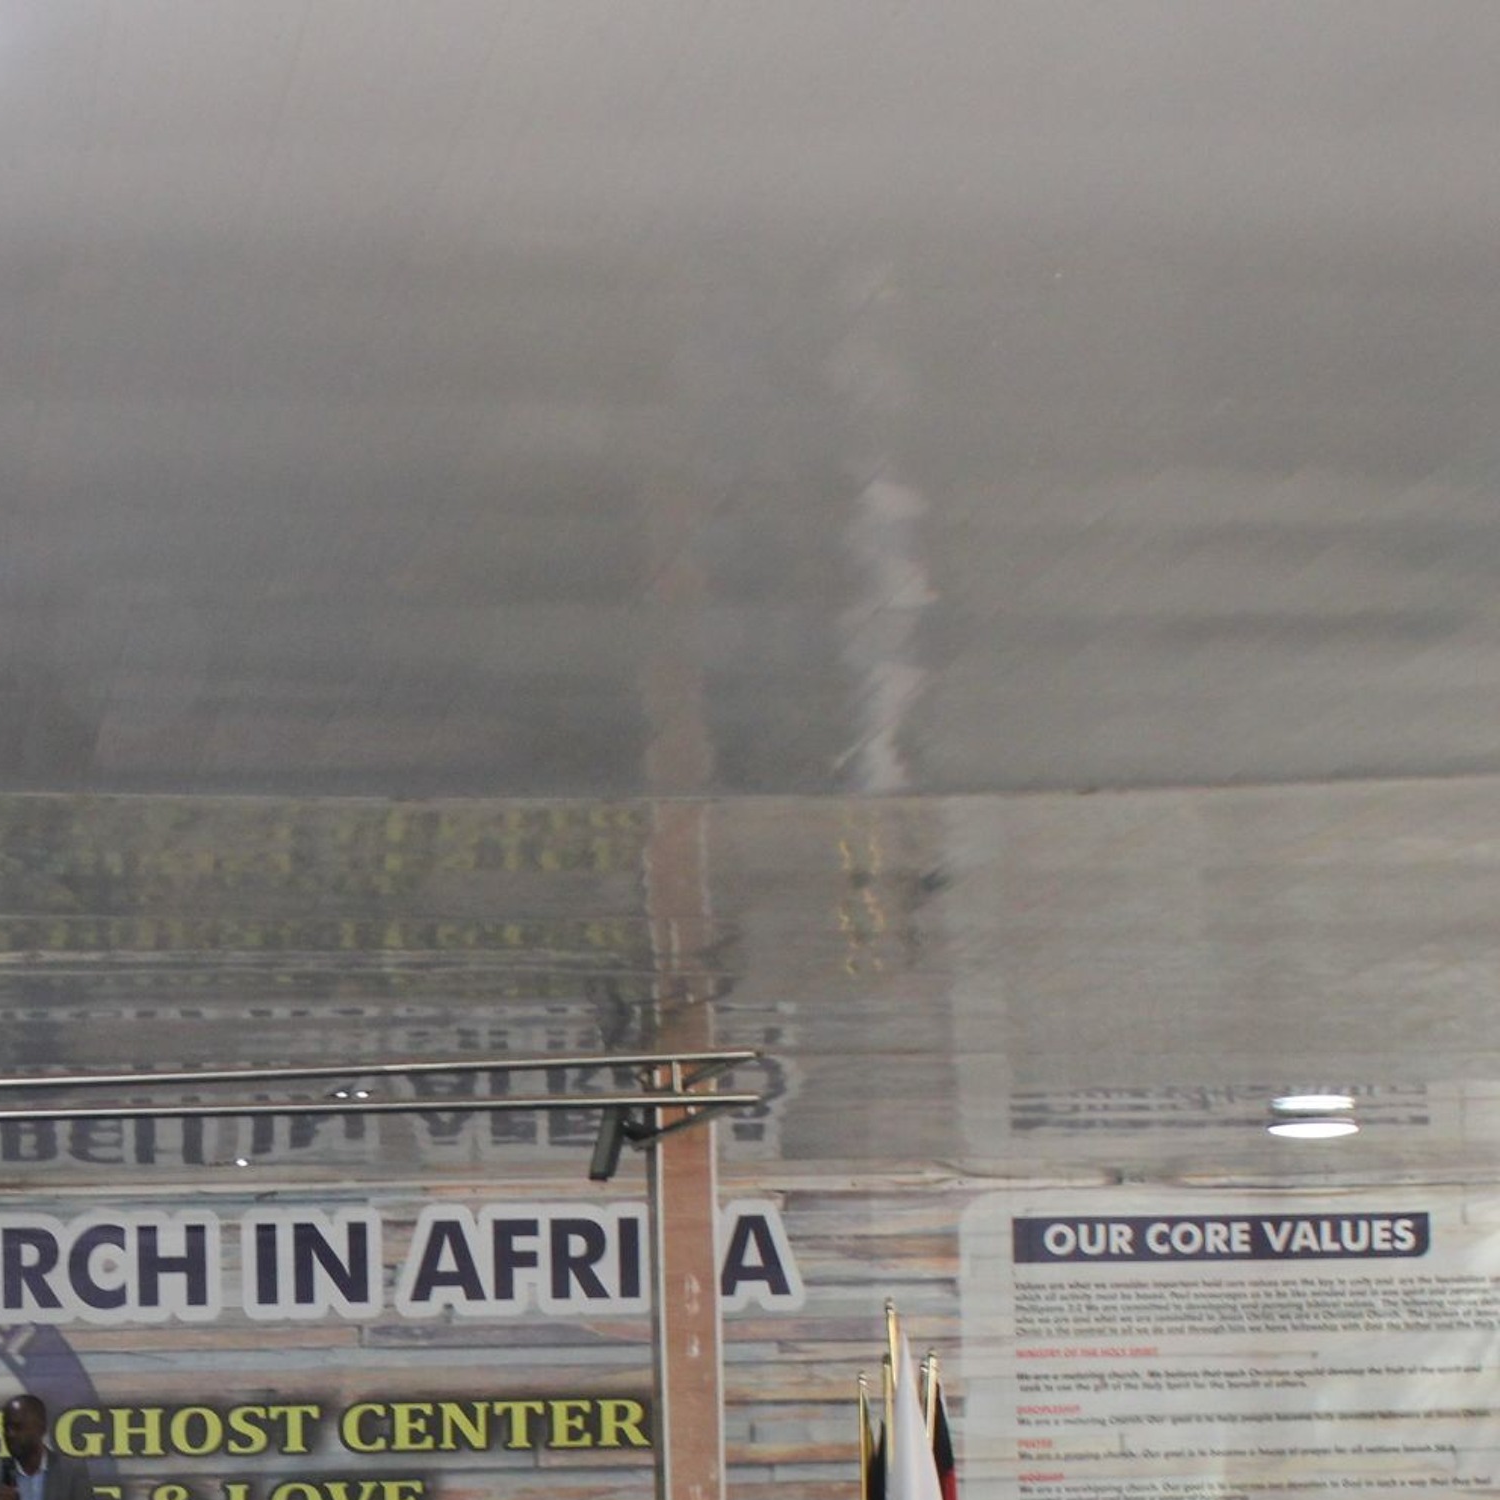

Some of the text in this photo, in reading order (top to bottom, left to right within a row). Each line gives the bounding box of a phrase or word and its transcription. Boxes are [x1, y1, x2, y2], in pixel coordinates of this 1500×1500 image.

[255, 1220, 369, 1306] IN
[410, 1214, 792, 1301] AFRIA
[1043, 1218, 1417, 1256] OUR CORE VALUES
[54, 1404, 320, 1459] GHOST
[340, 1398, 652, 1453] CENTER
